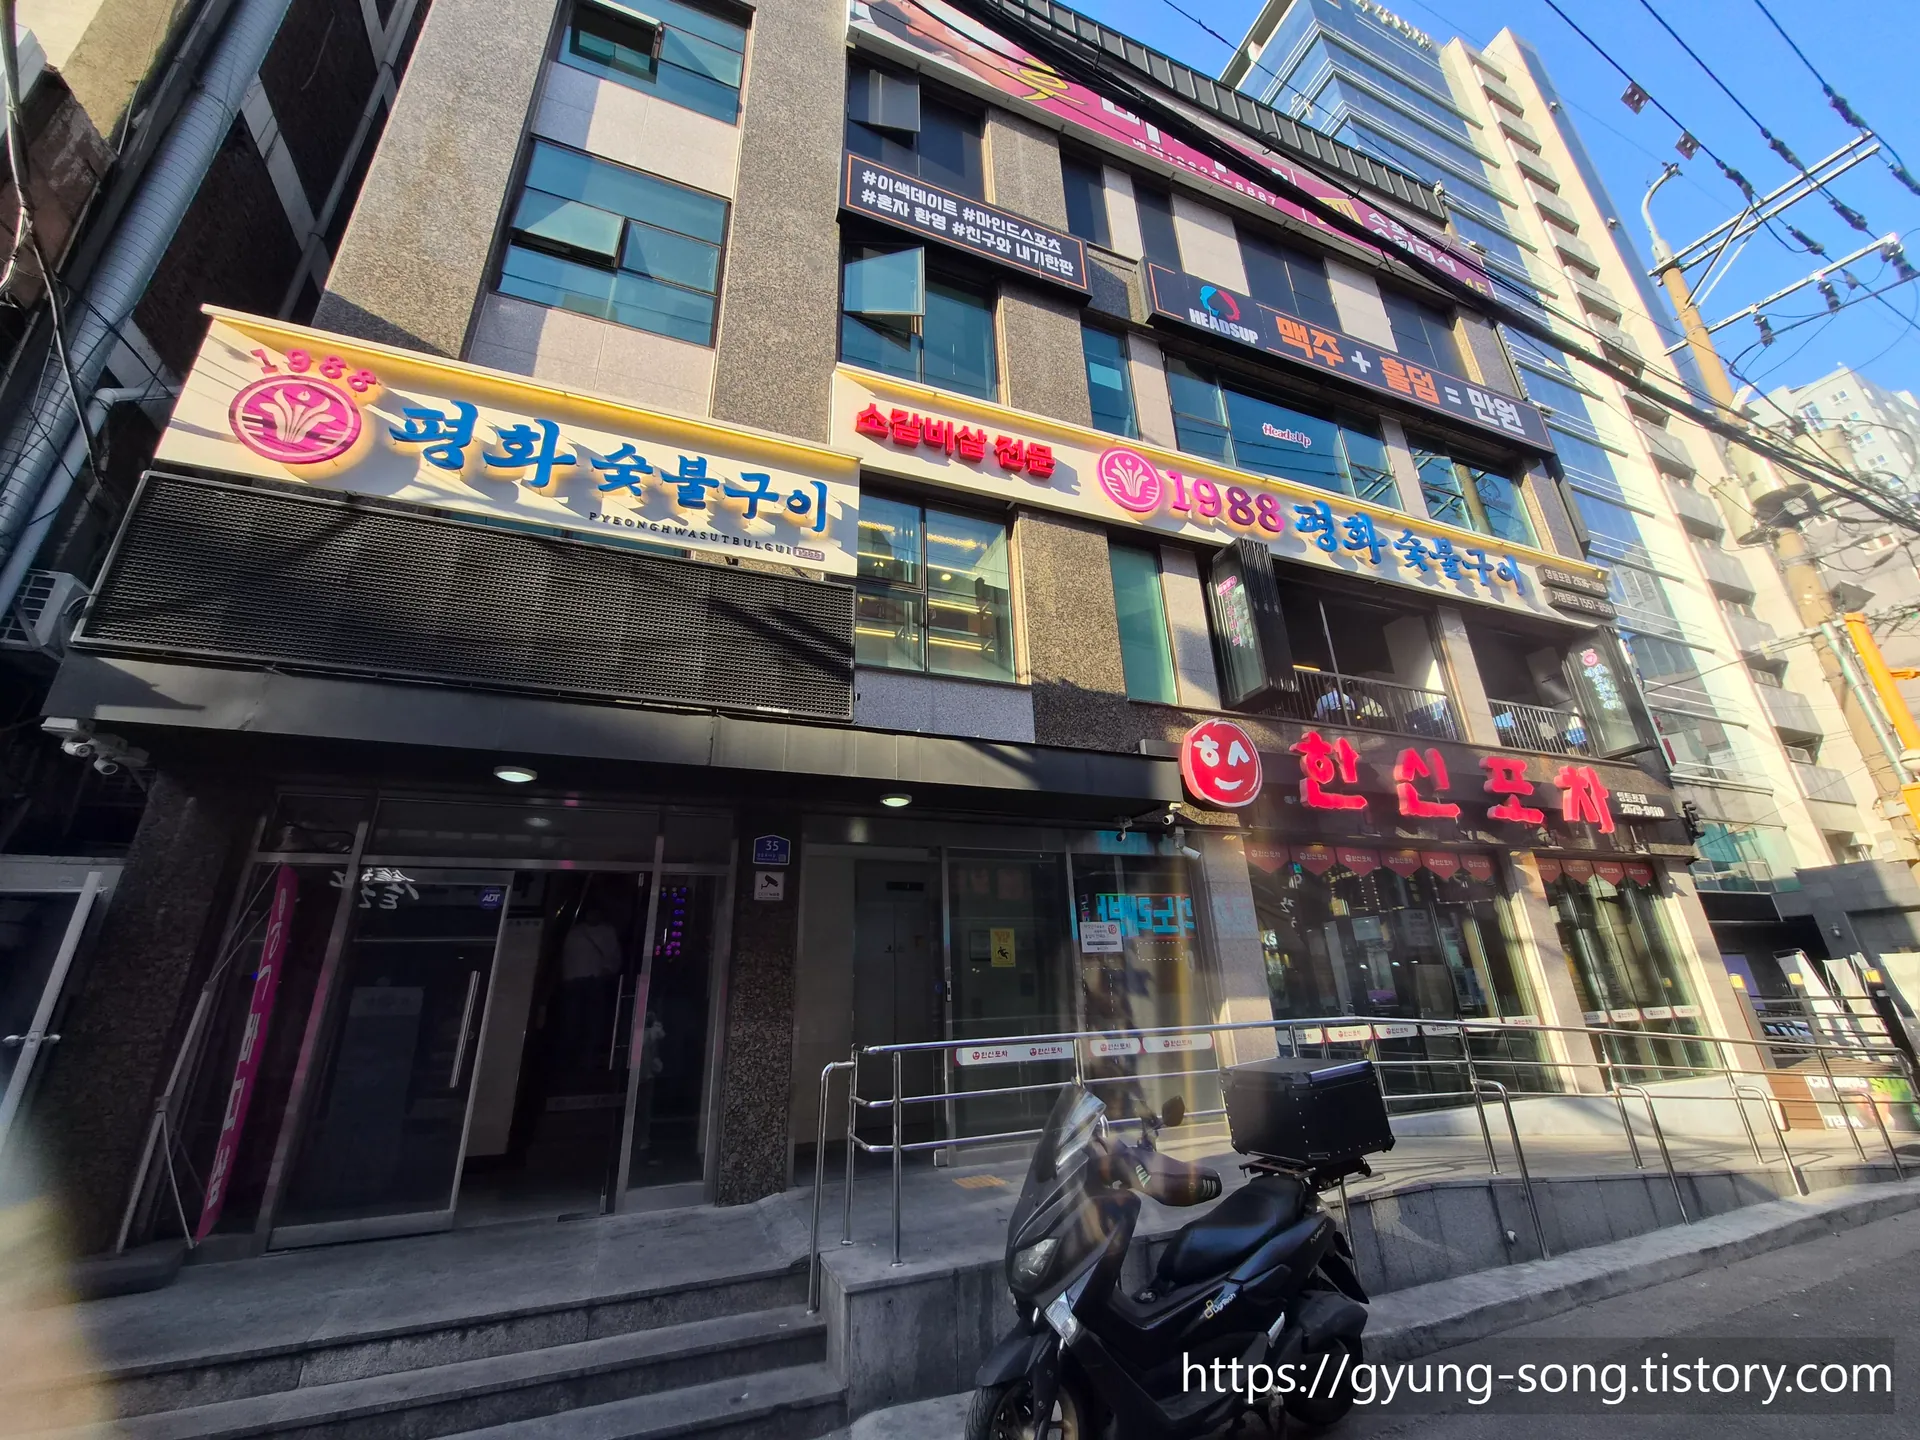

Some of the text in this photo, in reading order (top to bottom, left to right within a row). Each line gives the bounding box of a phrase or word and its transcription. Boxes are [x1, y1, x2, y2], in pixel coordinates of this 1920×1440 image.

[861, 188, 1074, 277] #혼자 환영 #친구와 내기한판
[862, 170, 1062, 255] #이색데이트 #마인드스포츠
[1189, 307, 1259, 345] HEADSUP
[250, 349, 377, 392] 1988
[1275, 315, 1345, 369] 맥주
[1379, 355, 1441, 406] 홀덤
[1468, 387, 1527, 436] 만원
[855, 403, 1056, 479] 소갈비살 전문
[1262, 422, 1313, 449] HeadsUp
[1165, 469, 1285, 533] 1988
[588, 511, 792, 555] PYEONGHWASUTBULGUI
[1289, 730, 1615, 834] 한신포차
[765, 840, 779, 851] 35
[482, 894, 500, 902] ADT
[981, 1049, 1008, 1059] 한신포차
[1038, 1046, 1063, 1056] 한신포차
